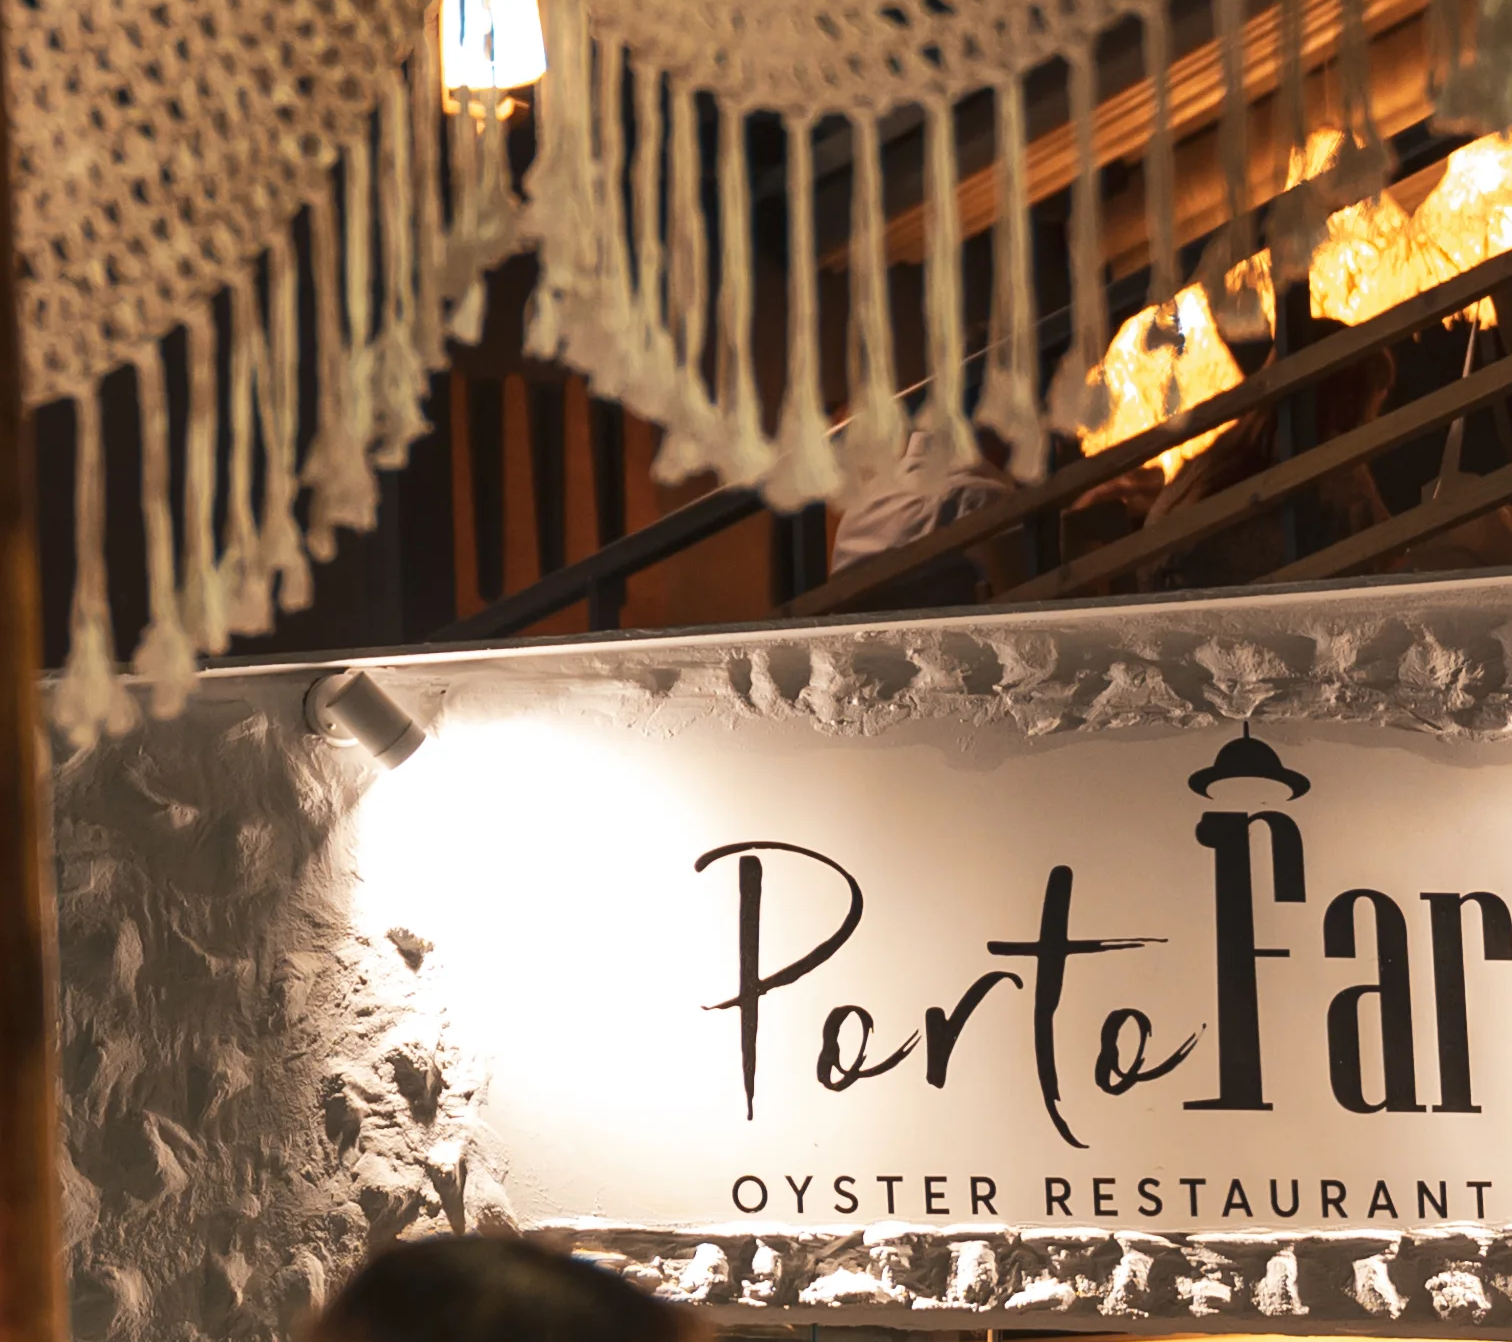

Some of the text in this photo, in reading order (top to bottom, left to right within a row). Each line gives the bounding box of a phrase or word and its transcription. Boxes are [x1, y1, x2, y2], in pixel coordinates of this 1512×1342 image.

[694, 840, 1207, 1150] Porto
[731, 1174, 999, 1216] OYSTER
[1043, 1176, 1493, 1220] RESTAURANT
